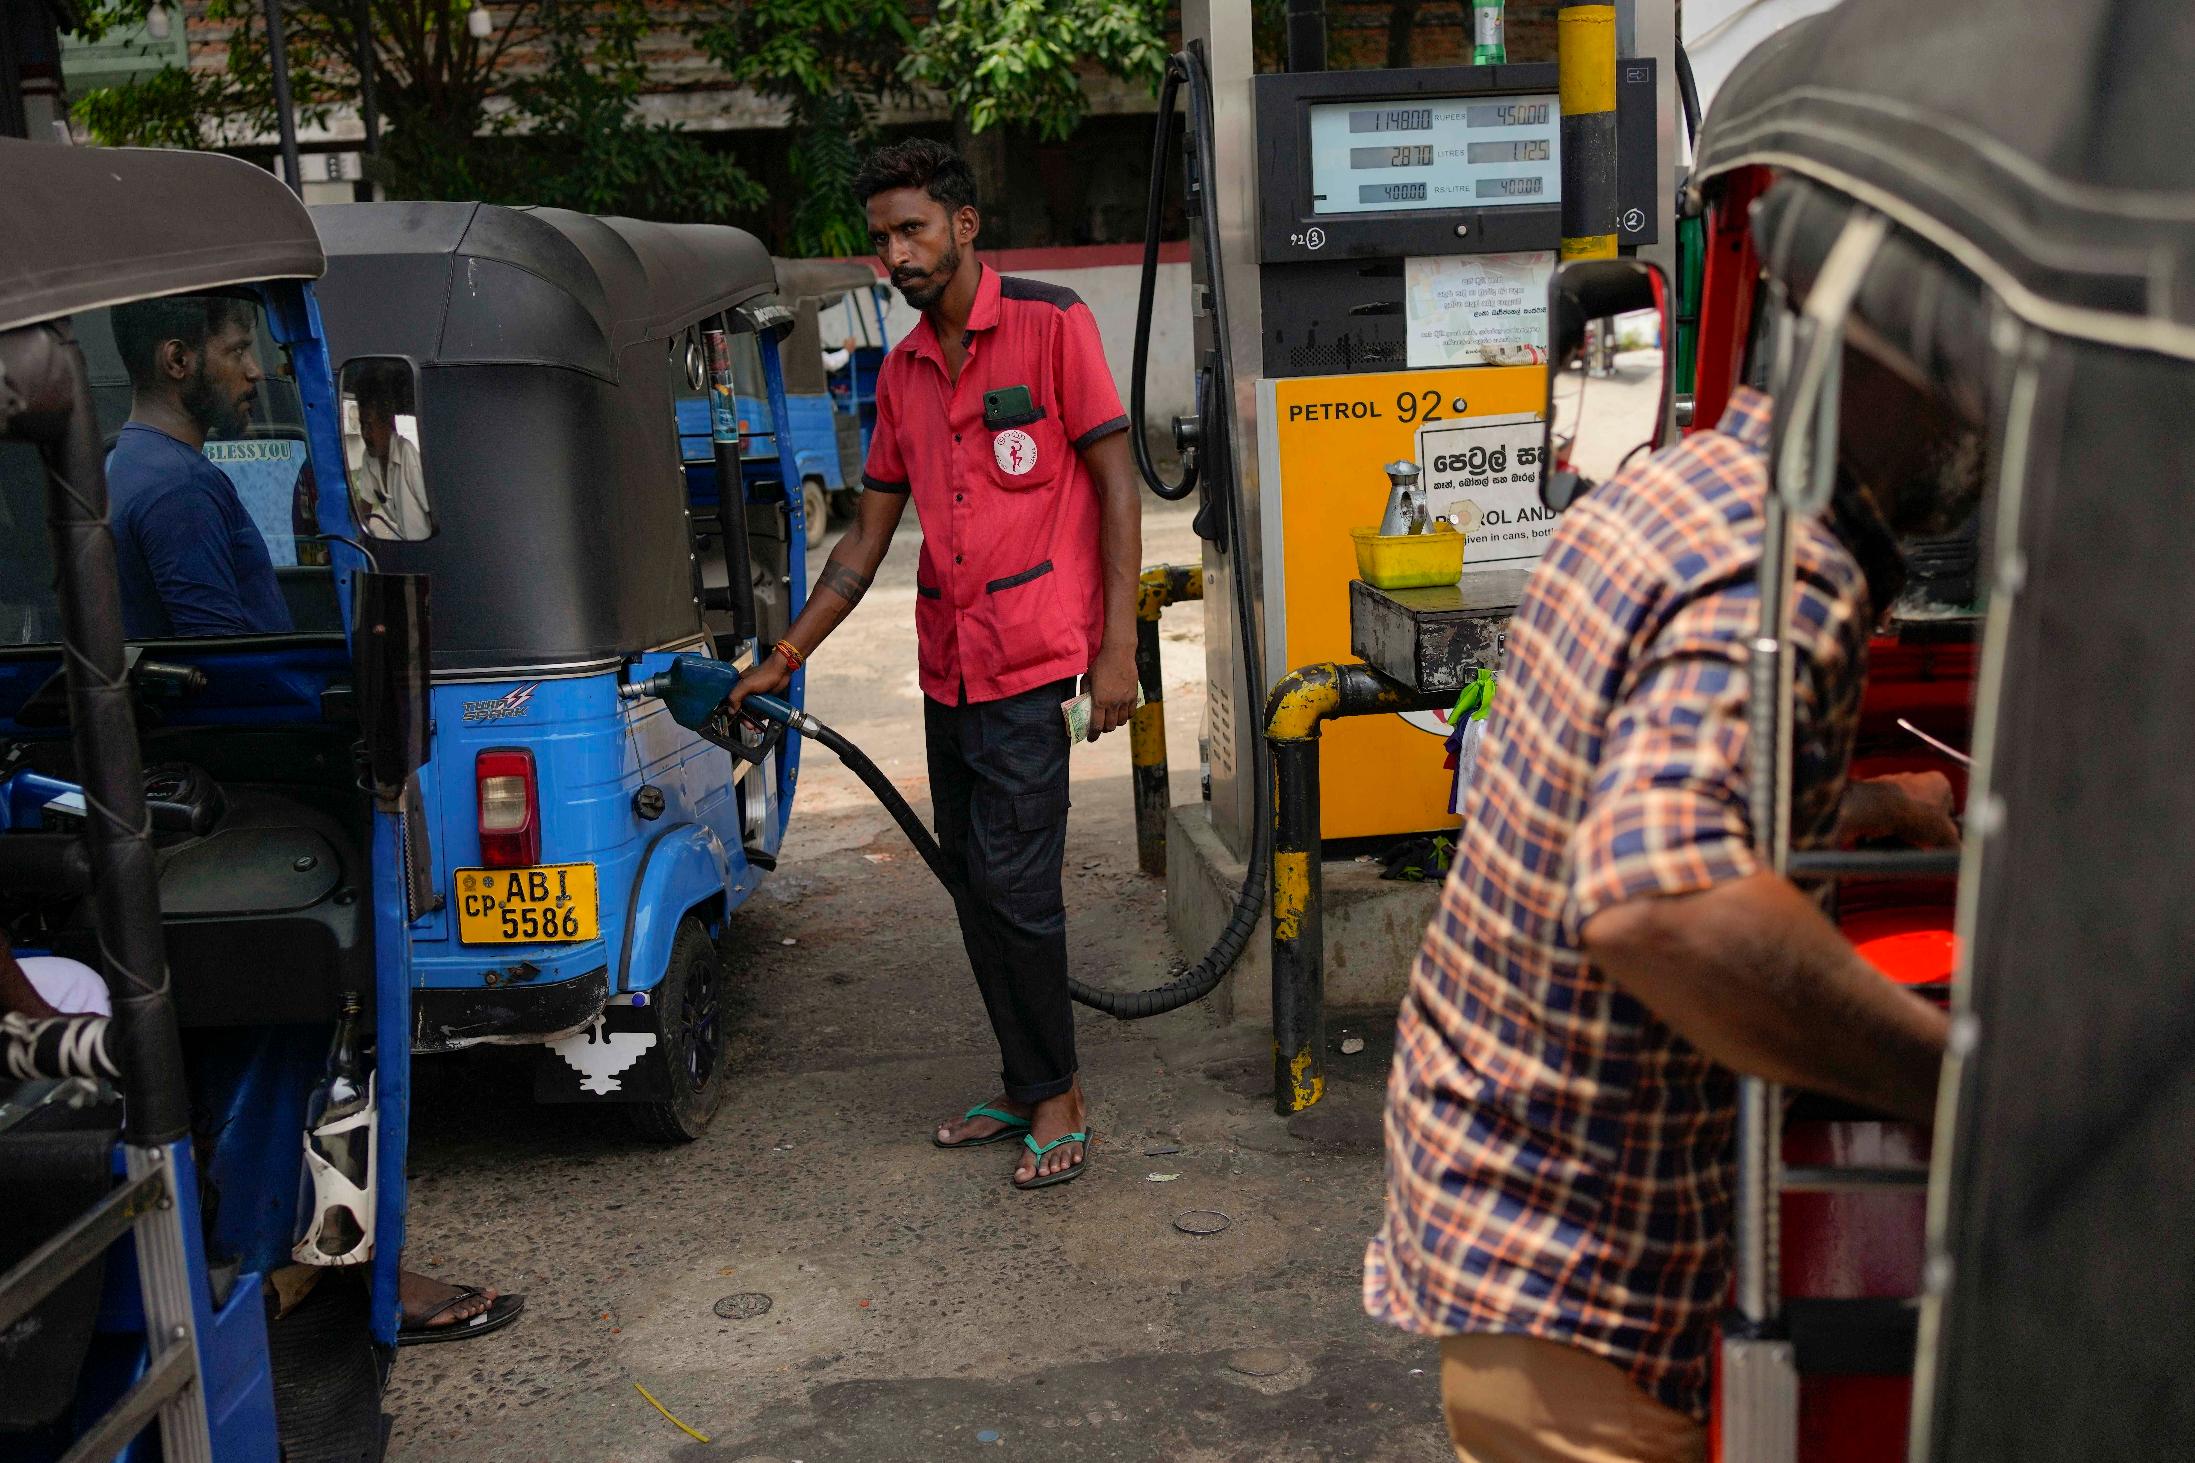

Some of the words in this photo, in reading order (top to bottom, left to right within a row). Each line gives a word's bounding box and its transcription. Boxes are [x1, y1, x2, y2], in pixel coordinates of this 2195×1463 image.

[1434, 113, 1466, 121] RUPEES
[1437, 149, 1465, 158] LITRES
[1289, 401, 1382, 422] PETROL
[1396, 390, 1442, 423] 92
[1516, 506, 1557, 523] AND
[1490, 533, 1500, 541] in
[1502, 531, 1529, 540] cans,
[462, 707, 529, 722] SPARK
[465, 894, 496, 917] CP
[501, 906, 579, 939] 5586
